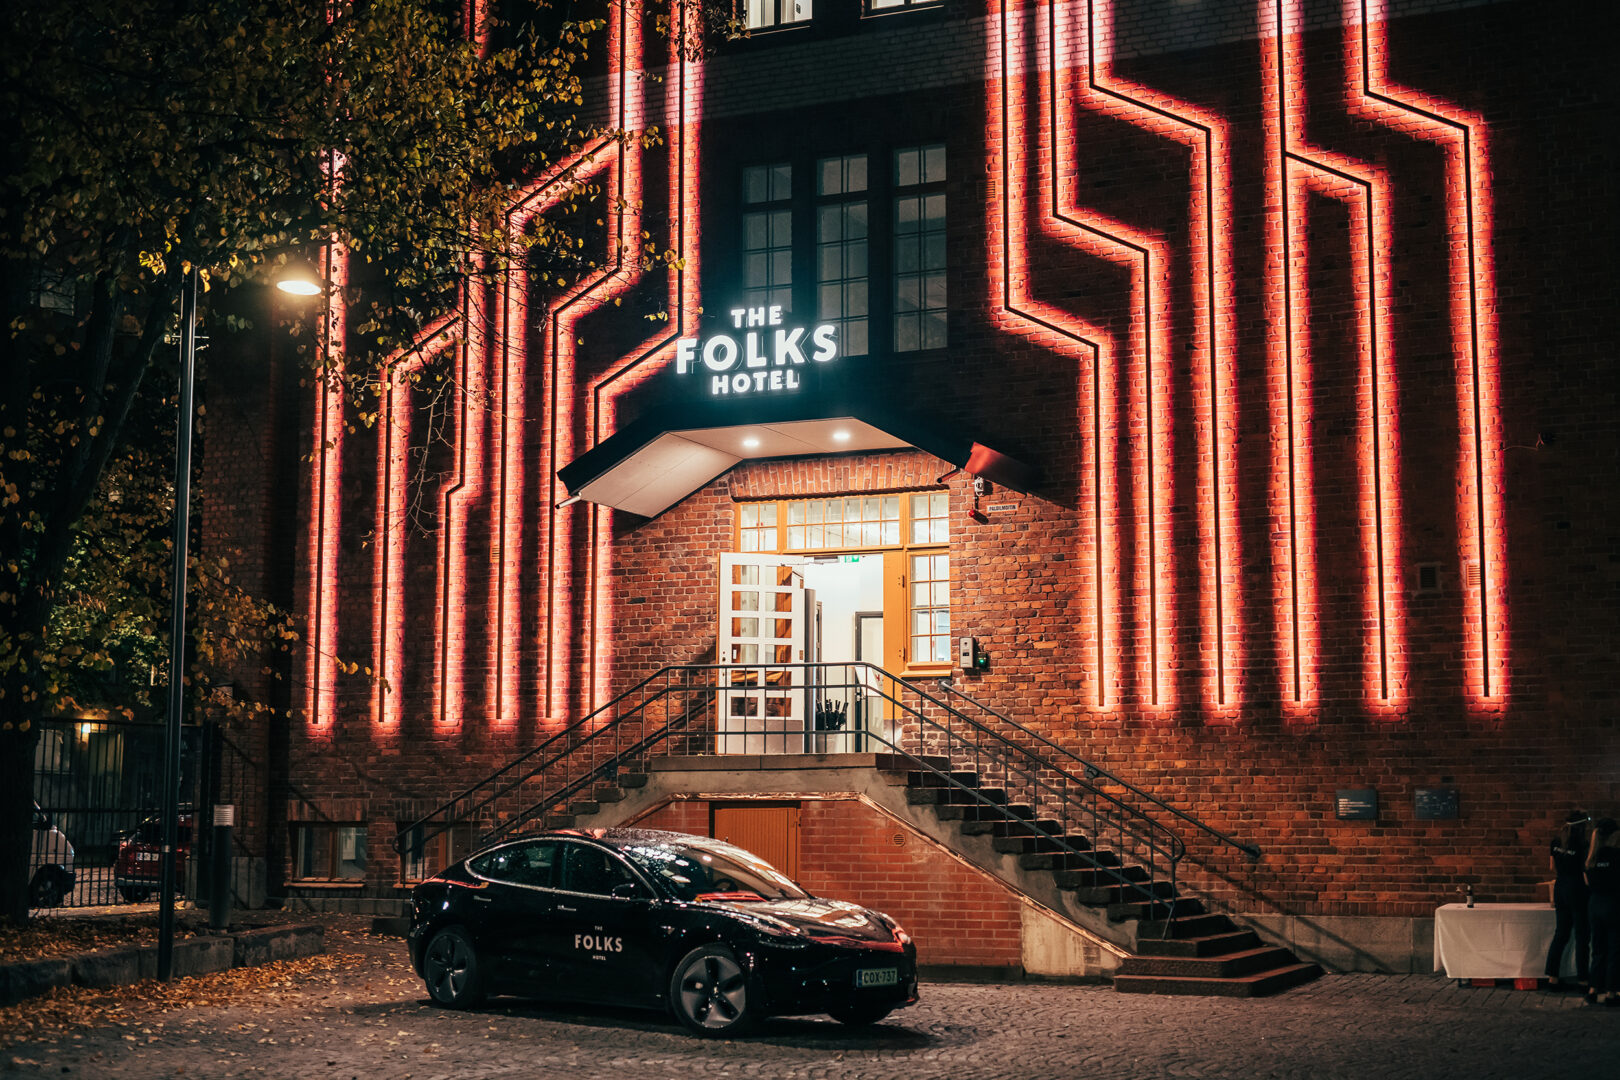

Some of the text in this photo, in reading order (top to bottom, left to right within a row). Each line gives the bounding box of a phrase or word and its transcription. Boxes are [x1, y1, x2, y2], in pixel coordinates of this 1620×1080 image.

[731, 305, 783, 328] THE
[676, 324, 838, 374] FOLKS
[712, 369, 800, 395] HOTEL
[574, 934, 623, 952] FOLKS
